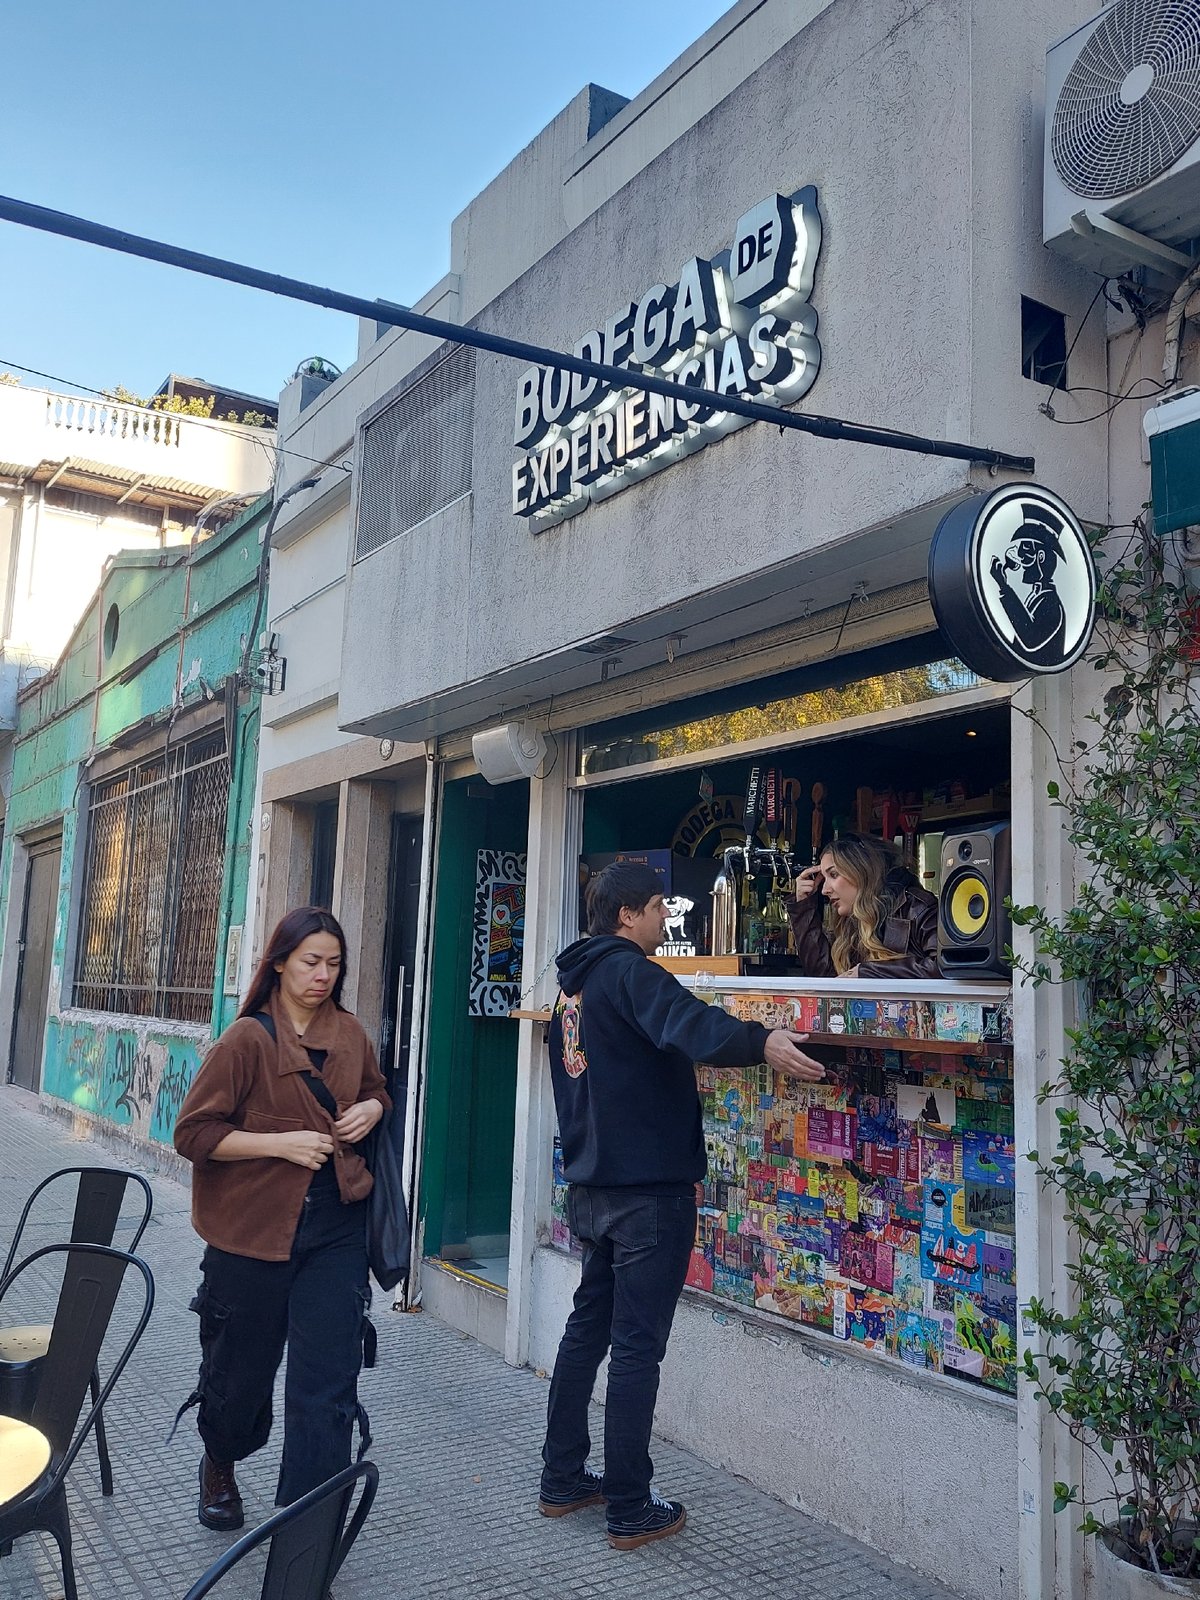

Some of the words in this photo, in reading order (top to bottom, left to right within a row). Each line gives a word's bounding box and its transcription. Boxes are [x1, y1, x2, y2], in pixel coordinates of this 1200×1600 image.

[737, 220, 775, 276] DE
[513, 256, 707, 448] BODEGA
[511, 313, 779, 517] EXPERIENCIAS
[746, 766, 760, 818] MARCHETTI
[767, 767, 776, 820] MARCHETTI
[673, 799, 736, 857] BODEGA
